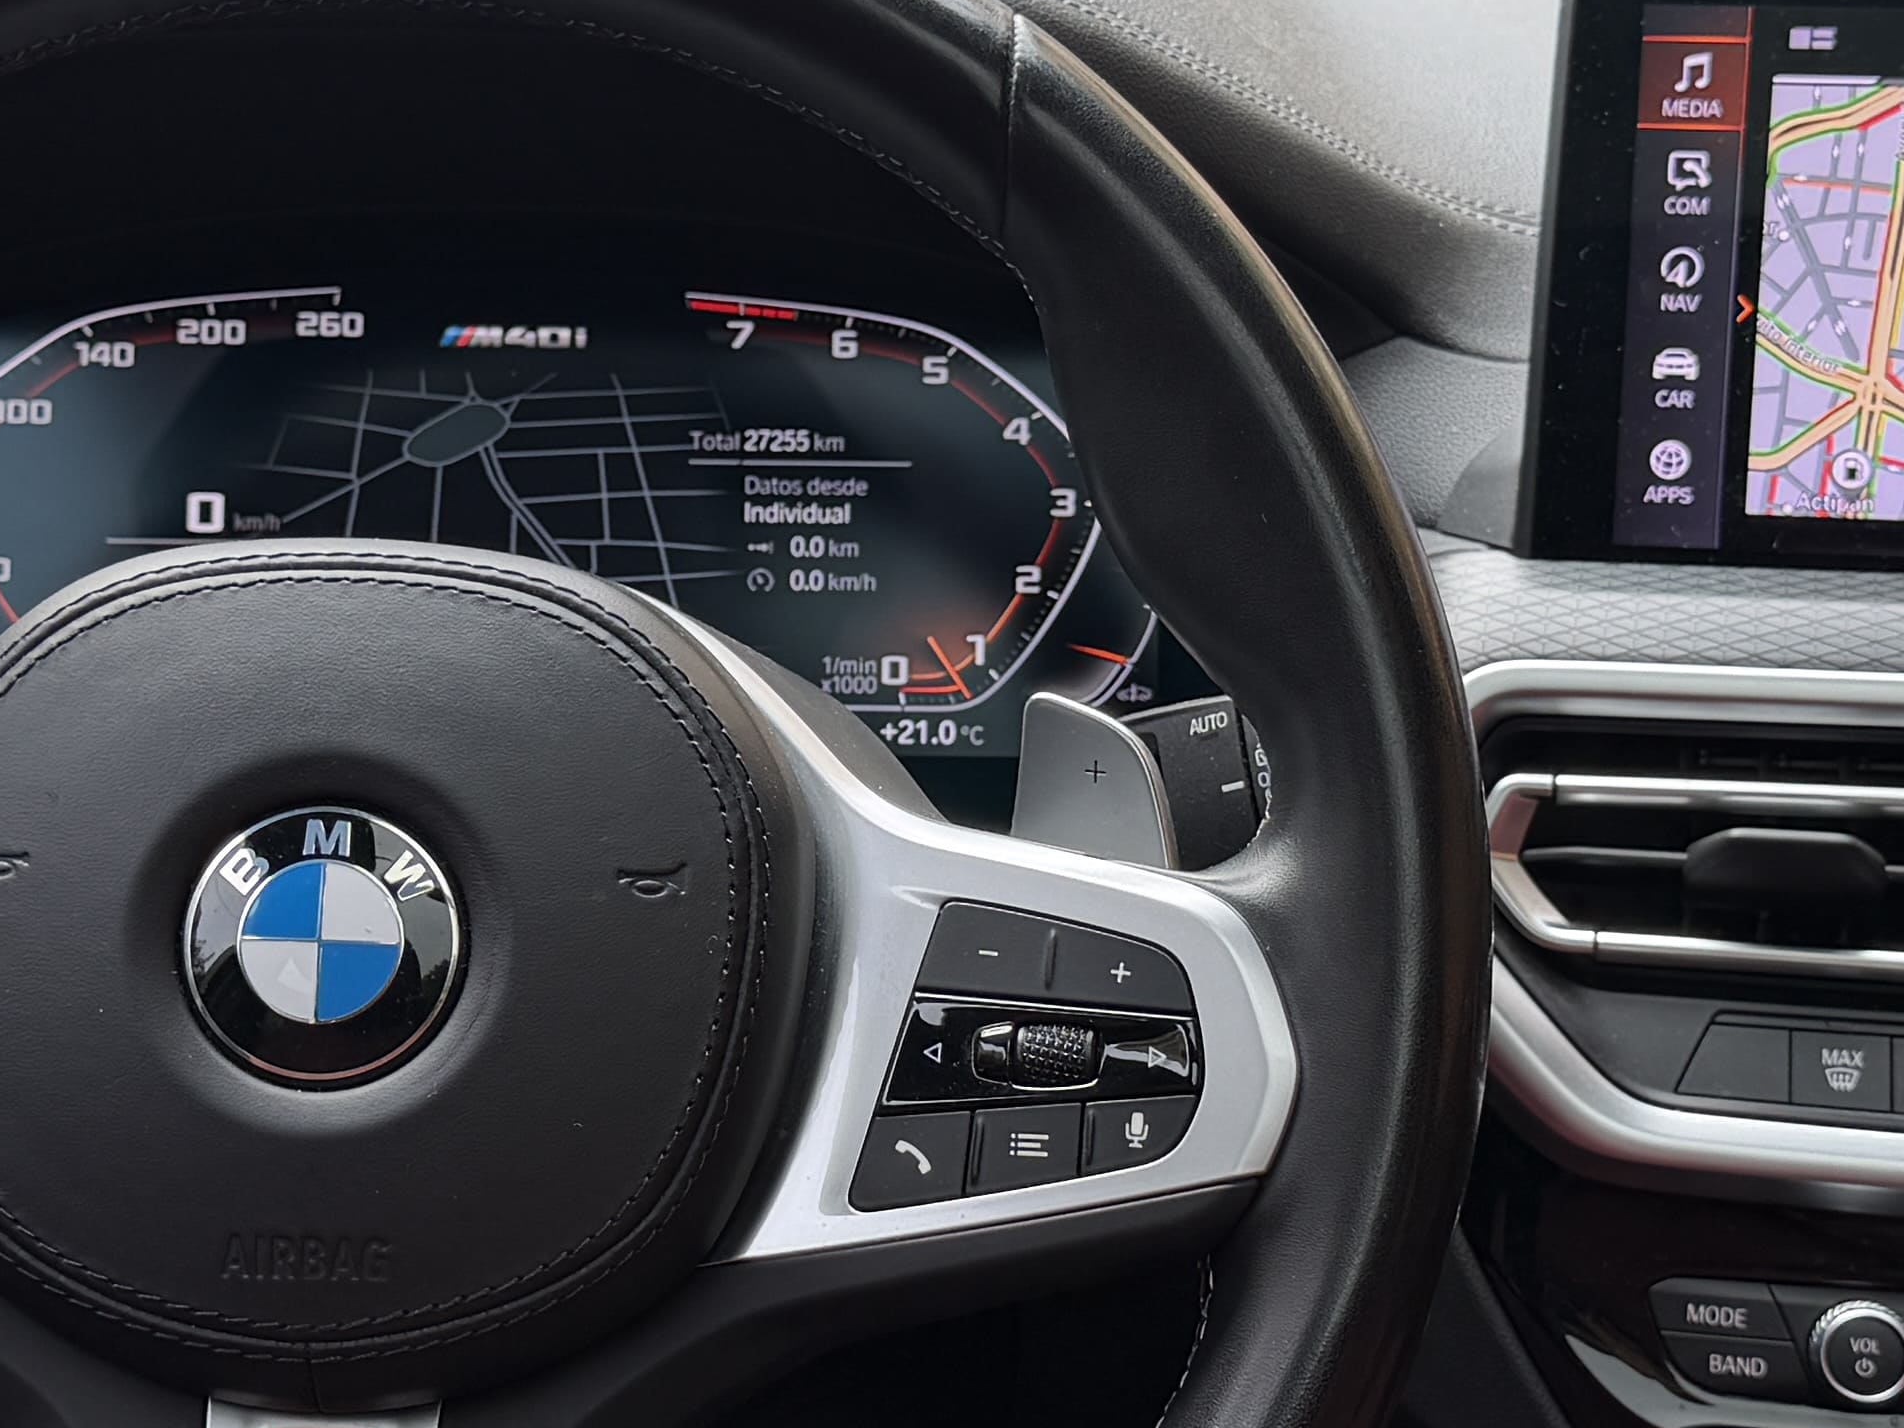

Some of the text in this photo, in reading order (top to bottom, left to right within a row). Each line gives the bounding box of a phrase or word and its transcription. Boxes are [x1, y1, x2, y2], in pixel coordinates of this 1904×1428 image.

[1661, 97, 1722, 119] MEDIA
[1663, 195, 1710, 216] COM
[1660, 293, 1701, 313] NAV
[176, 318, 247, 346] 200
[296, 311, 365, 339] 260
[728, 320, 755, 350] 7
[74, 341, 136, 369] 140
[830, 330, 860, 360] 6
[921, 356, 950, 386] 5
[1654, 389, 1695, 409] CAR
[688, 428, 846, 453] Total 27255 km
[1002, 416, 1033, 447] 4
[744, 475, 869, 497] Datos desde
[1643, 486, 1694, 505] APPS
[185, 491, 282, 535] 0 km/h
[744, 502, 852, 525] Individual
[1049, 487, 1078, 518] 3
[1796, 491, 1875, 515] Actipan
[789, 535, 860, 559] 0.0 km
[789, 569, 878, 593] 0.0 km/h
[1015, 565, 1043, 595] 2
[966, 634, 986, 667] 1
[822, 656, 878, 675] 1/min
[880, 655, 909, 686] 0
[822, 675, 878, 695] x1000
[879, 719, 958, 746] +21.0
[1188, 710, 1230, 737] AUTO
[220, 818, 434, 904] BMW
[1821, 1048, 1864, 1068] MAX
[220, 1233, 396, 1283] AIRBAG
[1686, 1303, 1747, 1329] MODE
[1849, 1337, 1881, 1354] VOL
[1708, 1353, 1768, 1378] BAND
